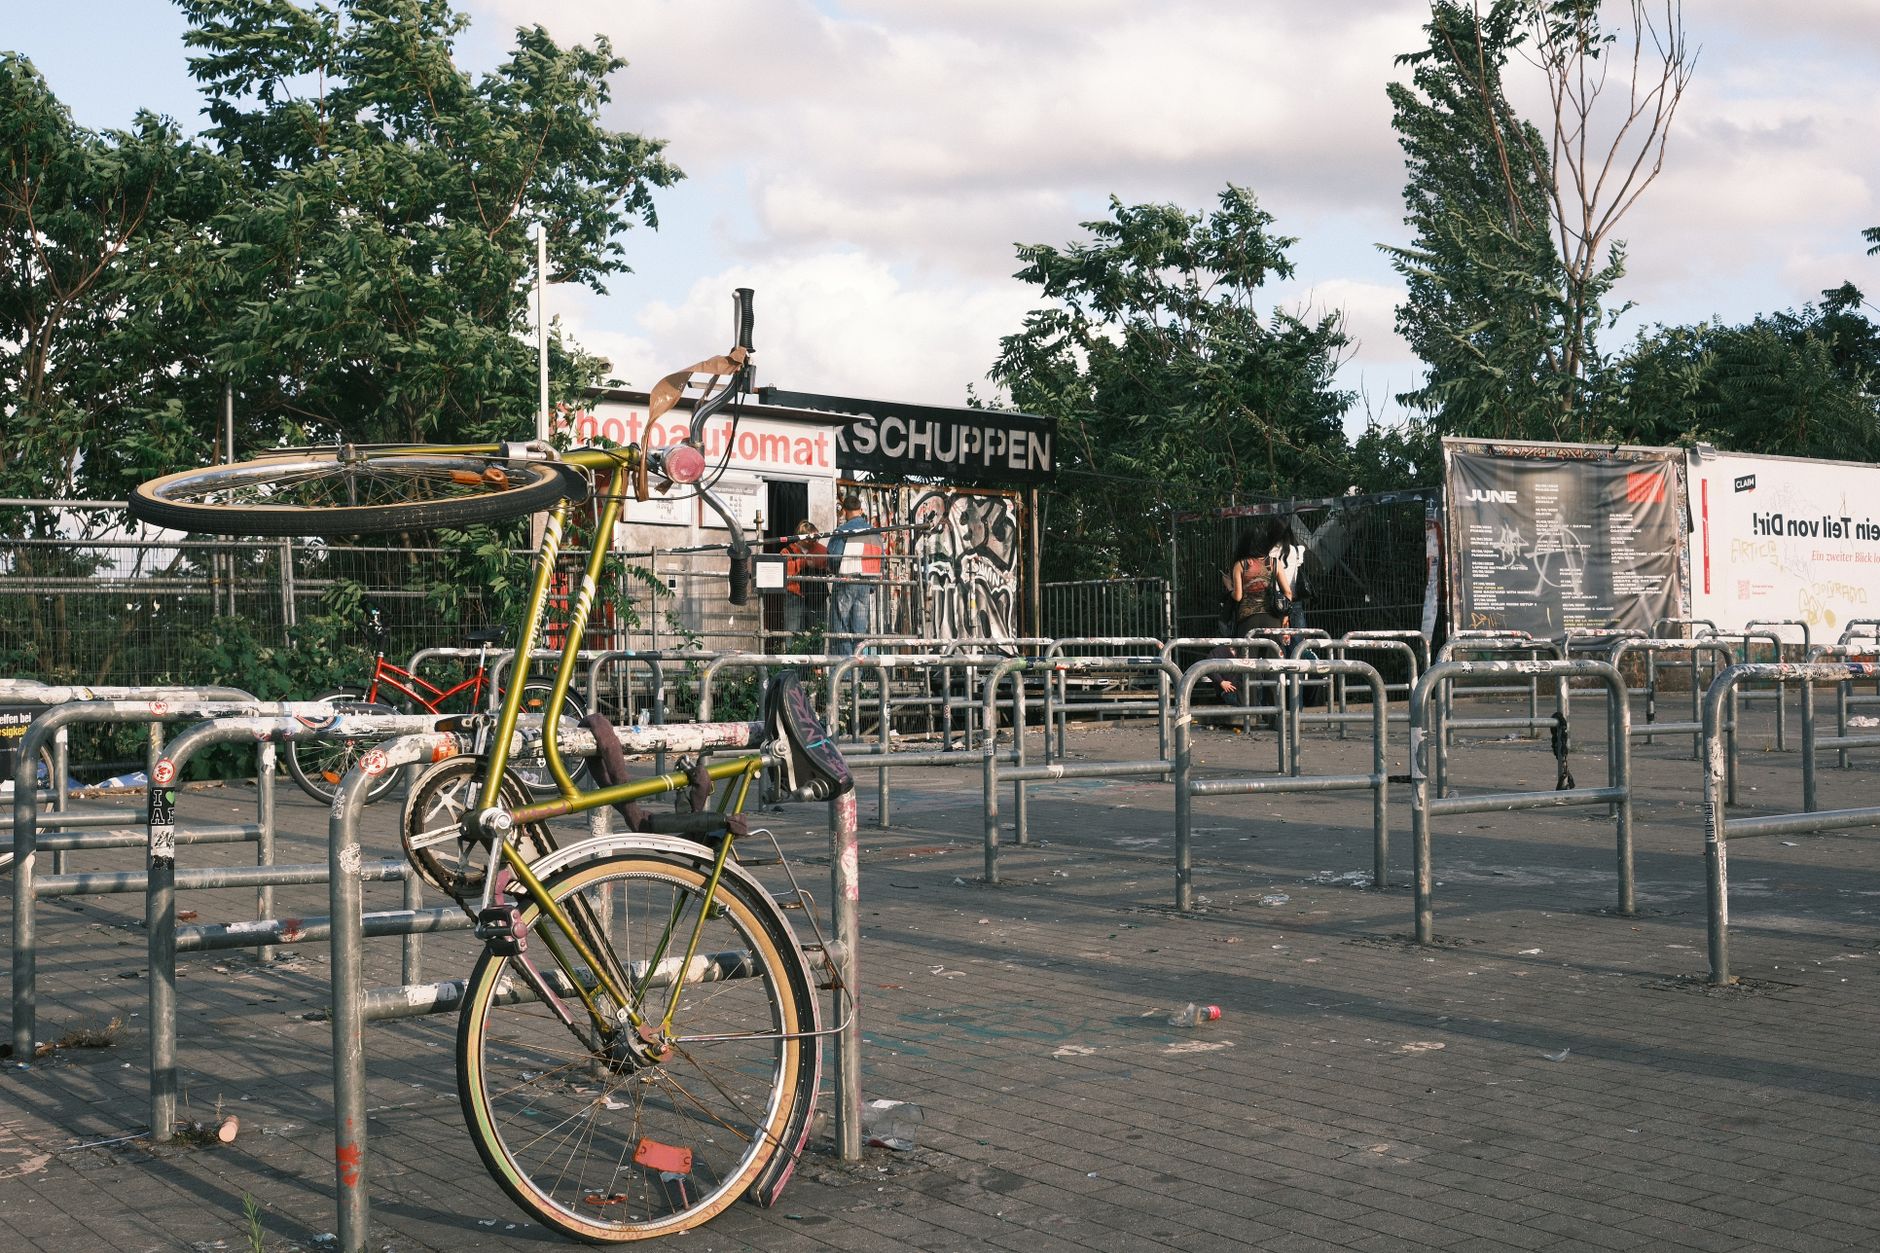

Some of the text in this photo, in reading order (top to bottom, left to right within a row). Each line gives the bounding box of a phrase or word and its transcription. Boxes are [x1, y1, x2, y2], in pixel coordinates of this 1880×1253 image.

[1735, 478, 1755, 489] CLAIM
[1465, 489, 1517, 504] JUNE
[1812, 550, 1824, 561] Ein
[1826, 551, 1852, 562] zweiter
[1855, 552, 1872, 563] Blick
[20, 712, 31, 724] bei
[153, 789, 163, 806] I
